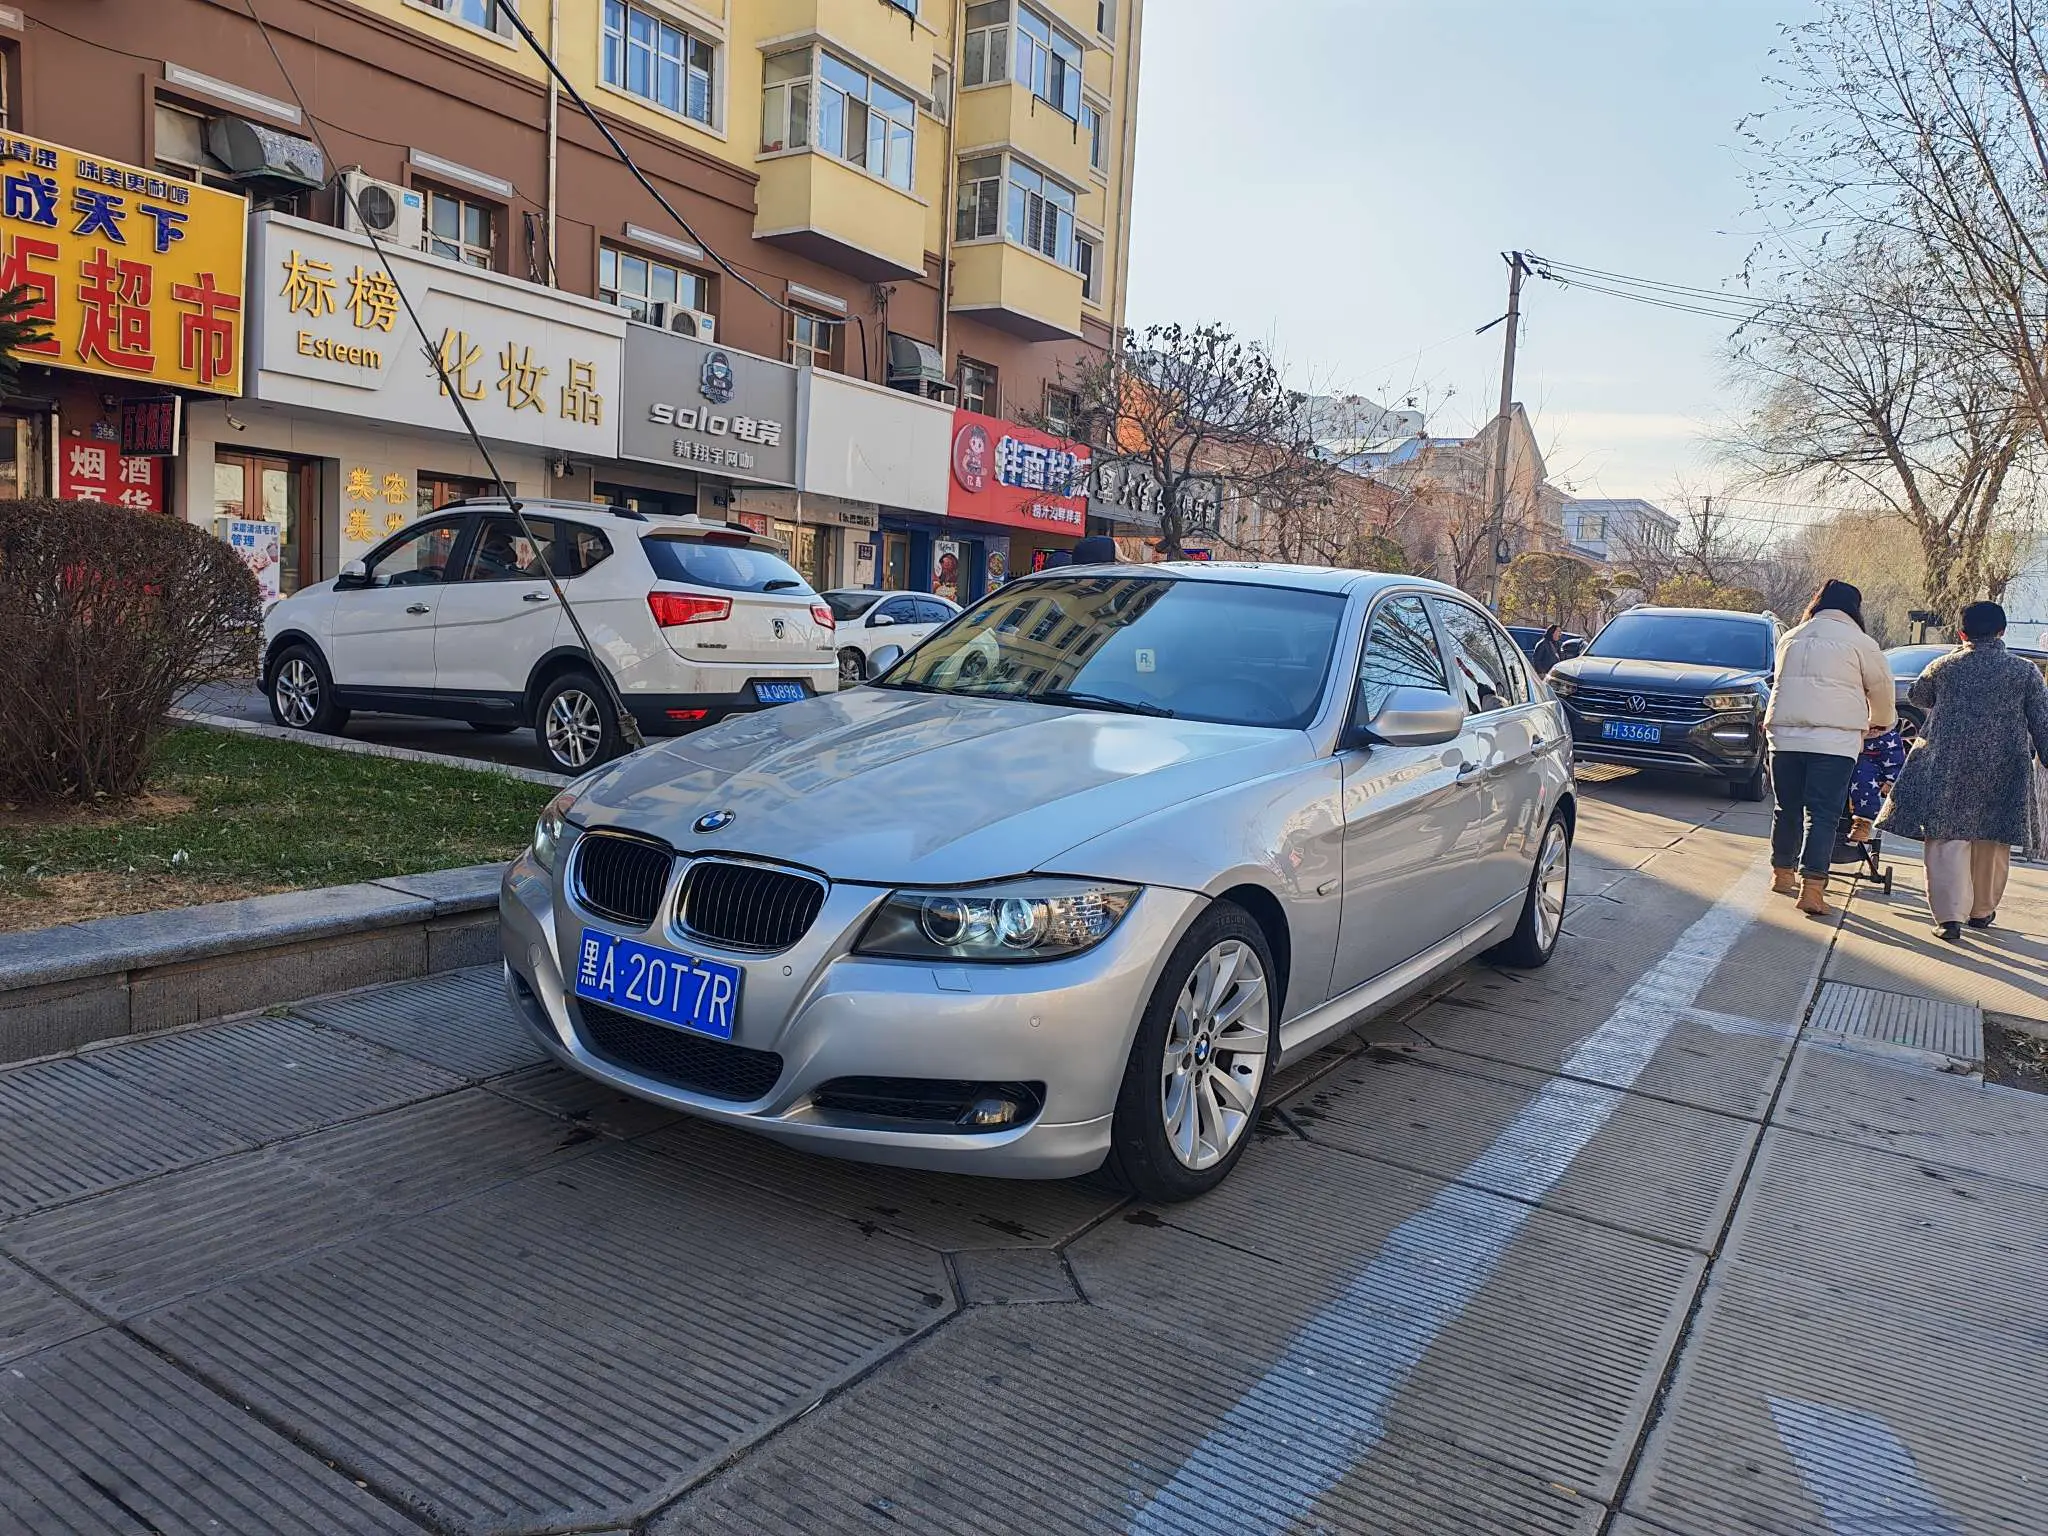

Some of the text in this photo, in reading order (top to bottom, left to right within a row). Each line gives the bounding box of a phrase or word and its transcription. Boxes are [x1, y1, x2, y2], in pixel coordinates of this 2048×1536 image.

[78, 160, 190, 205] 味美更耐嚼
[279, 250, 401, 333] 标榜
[297, 330, 383, 370] Esteem
[435, 327, 604, 426] 化妆品
[70, 445, 151, 485] 烟酒
[344, 465, 410, 506] 美容
[231, 534, 255, 547] 管理
